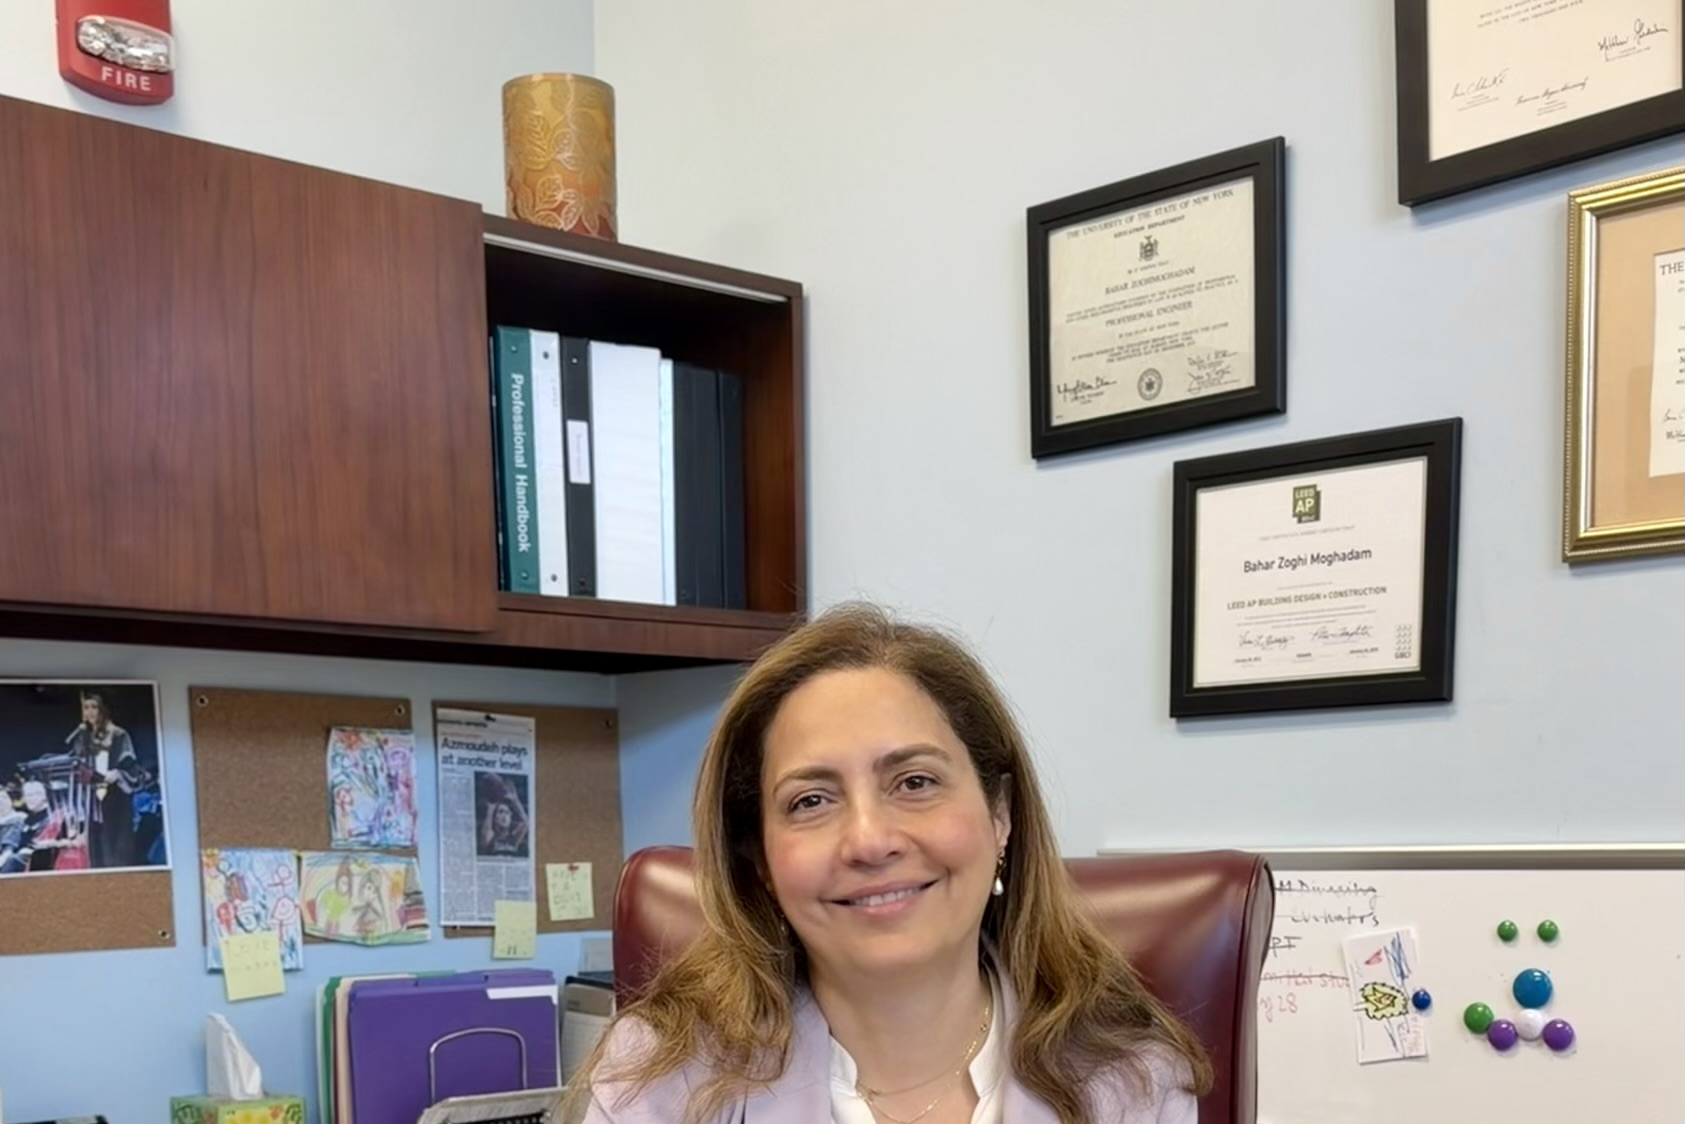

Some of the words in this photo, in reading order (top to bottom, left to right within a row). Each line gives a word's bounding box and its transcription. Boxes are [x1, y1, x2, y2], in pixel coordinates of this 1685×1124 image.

[101, 65, 151, 92] FIRE
[1067, 230, 1080, 240] THE
[1082, 217, 1123, 236] UNIVERSITY
[1125, 214, 1135, 224] OF
[1138, 208, 1153, 222] THE
[1154, 204, 1178, 217] STATE
[1180, 200, 1190, 209] OF
[1192, 193, 1211, 206] NEW
[1213, 188, 1234, 200] YORK
[1148, 215, 1185, 230] DEPARTMENT
[1659, 260, 1685, 276] THE
[1105, 310, 1154, 327] PROFESSIONAL
[1156, 300, 1193, 317] ENGINEER
[511, 373, 529, 469] Professional
[1295, 487, 1315, 499] LEED
[515, 474, 530, 553] Handbook
[1295, 498, 1315, 514] AP
[1243, 560, 1275, 573] Bahar
[1278, 554, 1308, 571] Zoghi
[1310, 548, 1372, 567] Moghadam
[1227, 601, 1246, 610] LEED
[1247, 599, 1257, 608] AP
[1258, 594, 1293, 607] BUILDING
[1294, 593, 1321, 604] DESIGN
[1328, 586, 1387, 600] CONSTRUCTION
[441, 737, 500, 754] Azmoudeh
[501, 744, 528, 757] plays
[441, 754, 454, 765] at
[457, 756, 497, 769] another
[499, 759, 523, 771] level
